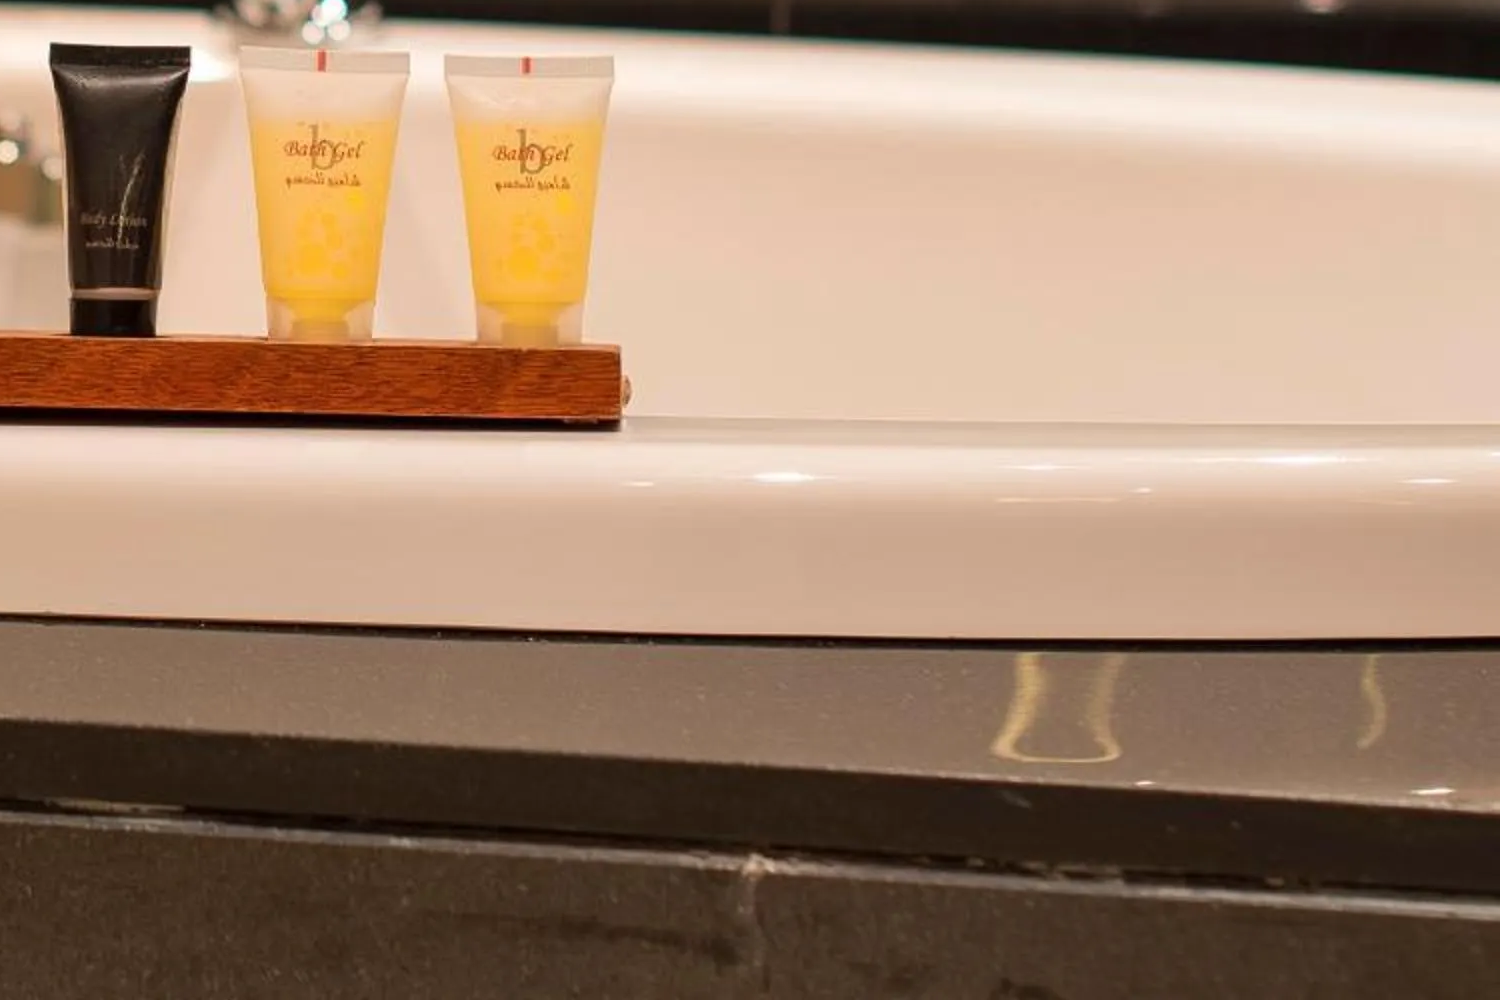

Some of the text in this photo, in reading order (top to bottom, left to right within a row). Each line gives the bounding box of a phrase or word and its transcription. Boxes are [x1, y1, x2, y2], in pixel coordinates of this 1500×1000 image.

[283, 139, 368, 164] Bath Gel
[492, 143, 574, 167] Bath Gel
